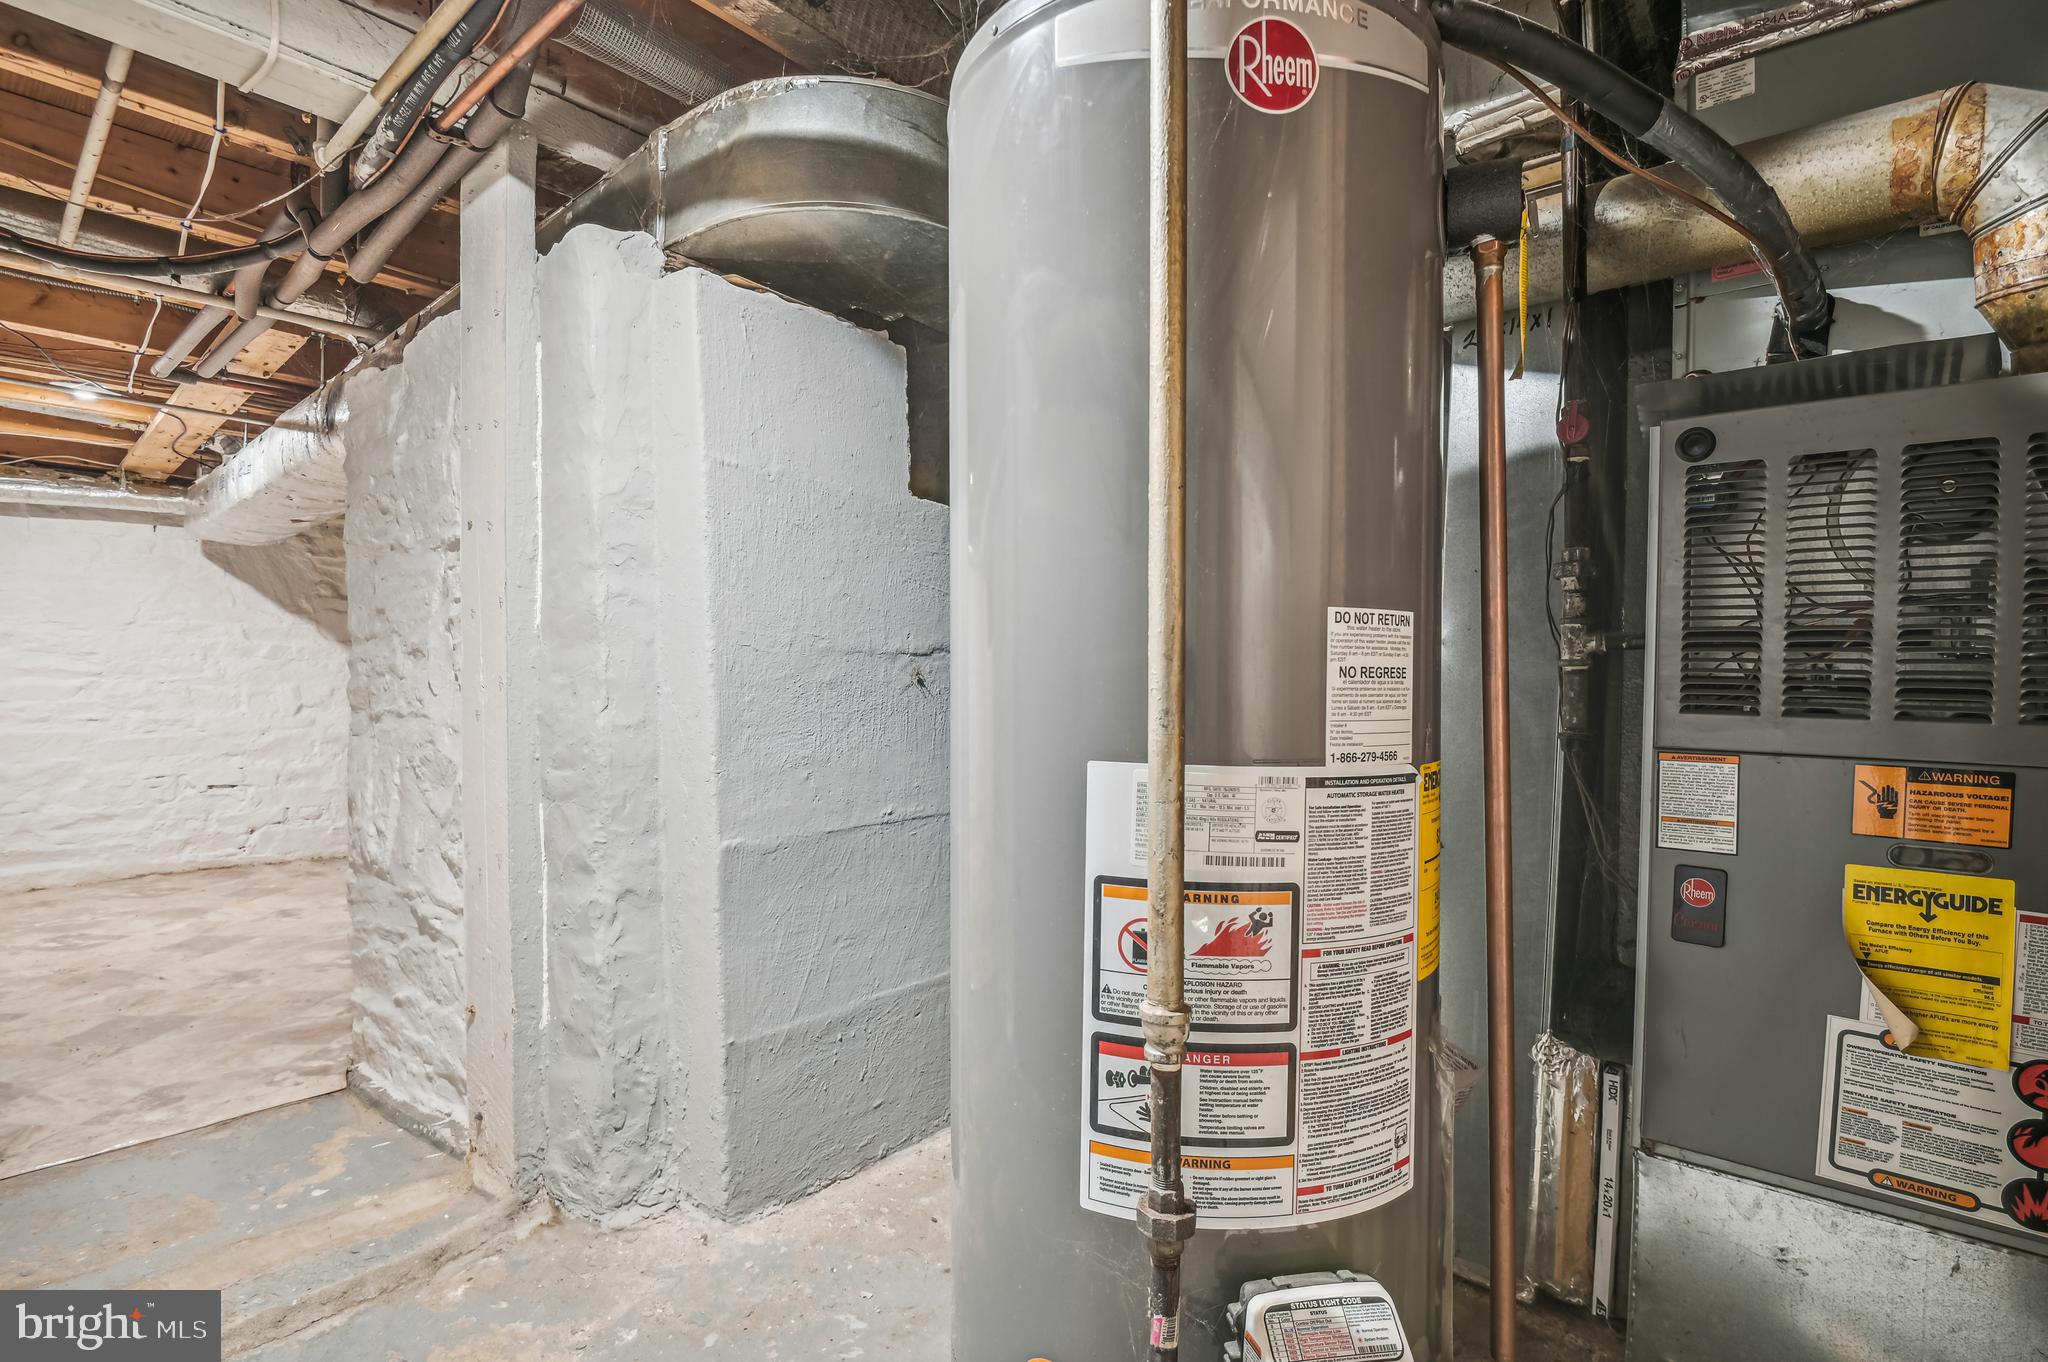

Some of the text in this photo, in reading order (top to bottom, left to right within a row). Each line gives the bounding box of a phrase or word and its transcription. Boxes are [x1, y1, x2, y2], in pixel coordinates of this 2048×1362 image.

[1239, 20, 1313, 97] Rheem
[1335, 611, 1410, 626] DO NOT RETURN
[1339, 666, 1406, 678] NO REGRESE
[1330, 751, 1398, 763] 1-866-279-4566
[1932, 772, 2000, 785] WARNING
[1910, 790, 2010, 802] HAZARDOUS VOLTAGE!
[1682, 879, 1714, 900] Rheem
[1184, 894, 1240, 904] ARNING
[1853, 884, 2003, 922] ENERGYGUIDE
[1866, 920, 1894, 928] Compare
[1908, 925, 1930, 933] Energy
[1932, 928, 1965, 938] Efficiency
[1868, 926, 1892, 935] Furnace
[1908, 932, 1929, 940] Others
[1967, 939, 1981, 947] Buy.
[1885, 964, 1910, 972] efficiency
[1978, 1022, 1999, 1030] energy
[1184, 1054, 1230, 1064] ANGER
[1846, 1044, 1987, 1076] OWNER/OPERATOR SAFETY INFORMATION
[1608, 1080, 1618, 1102] HDX
[1843, 1090, 1957, 1118] INSTALLER SAFETY INFORMATION
[1896, 1180, 1957, 1202] WARNING
[1290, 1300, 1318, 1310] STATUS
[1319, 1298, 1340, 1307] LIGHT
